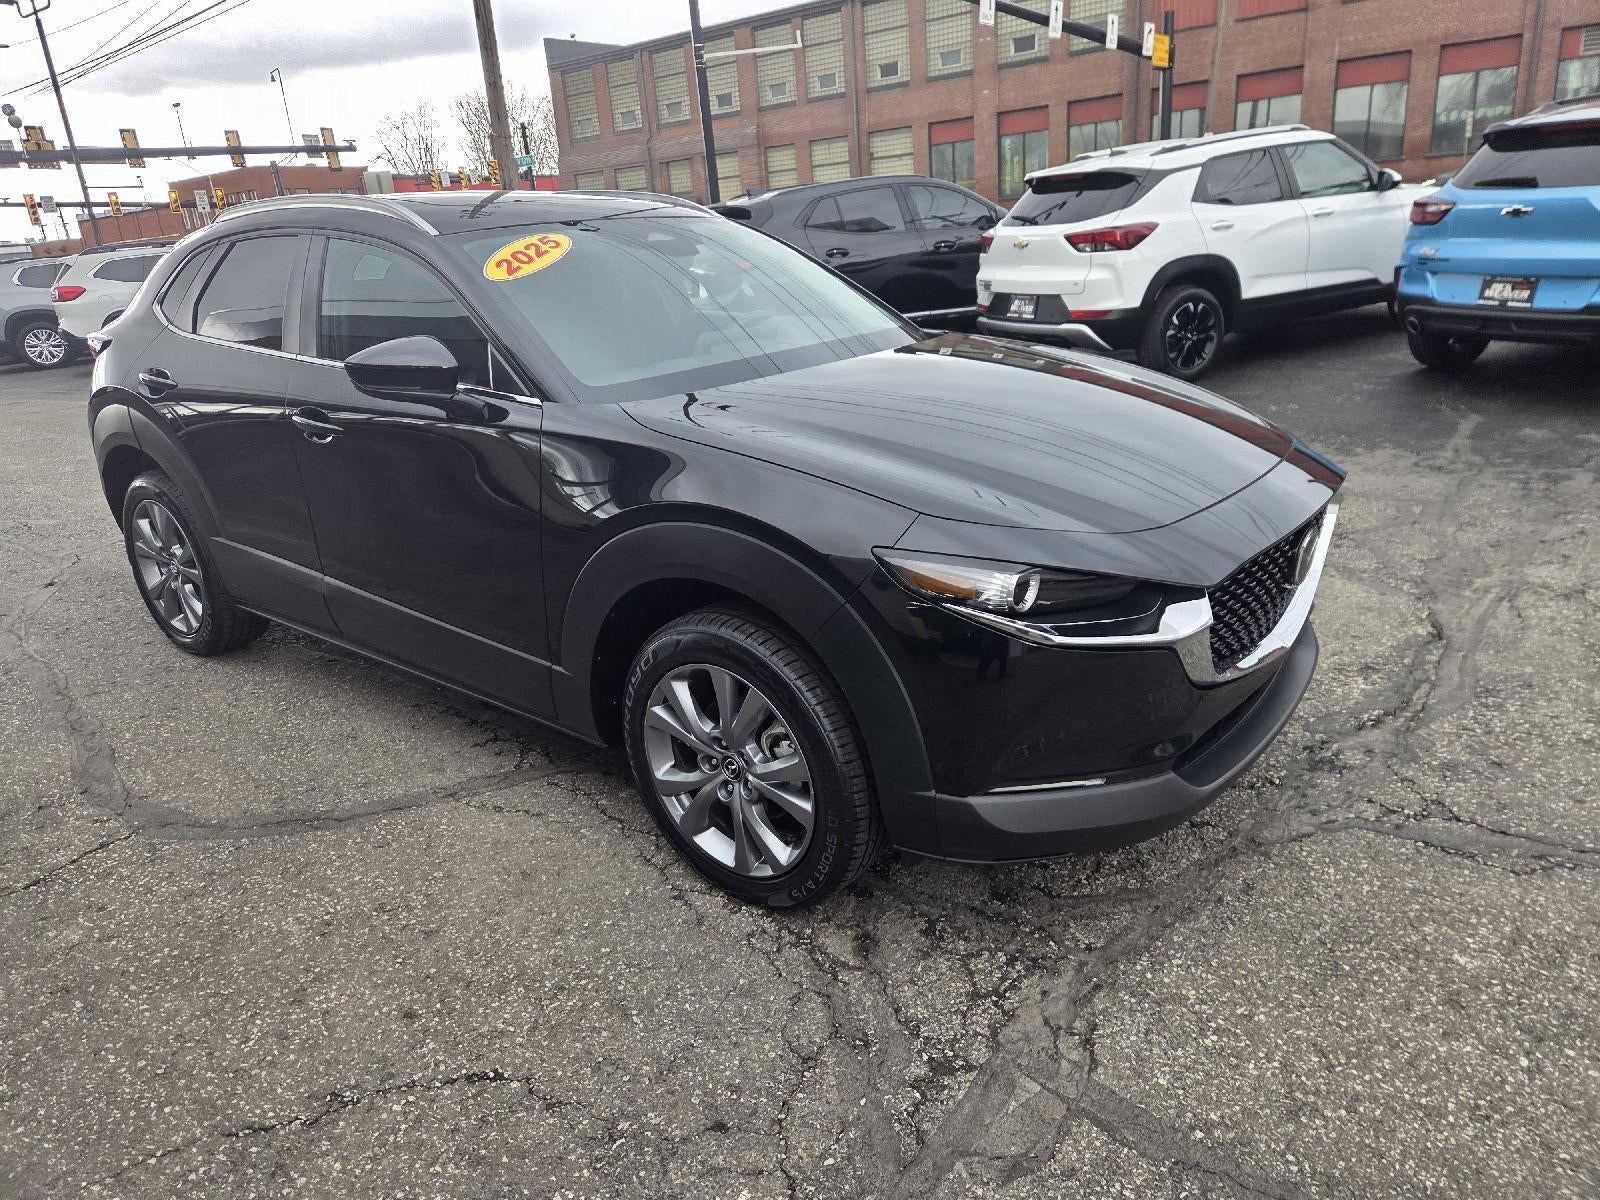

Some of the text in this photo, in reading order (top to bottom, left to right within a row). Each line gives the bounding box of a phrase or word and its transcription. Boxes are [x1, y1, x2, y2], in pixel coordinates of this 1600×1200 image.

[495, 236, 561, 276] 2025
[813, 831, 837, 881] SPORT
[791, 878, 816, 899] A/S
